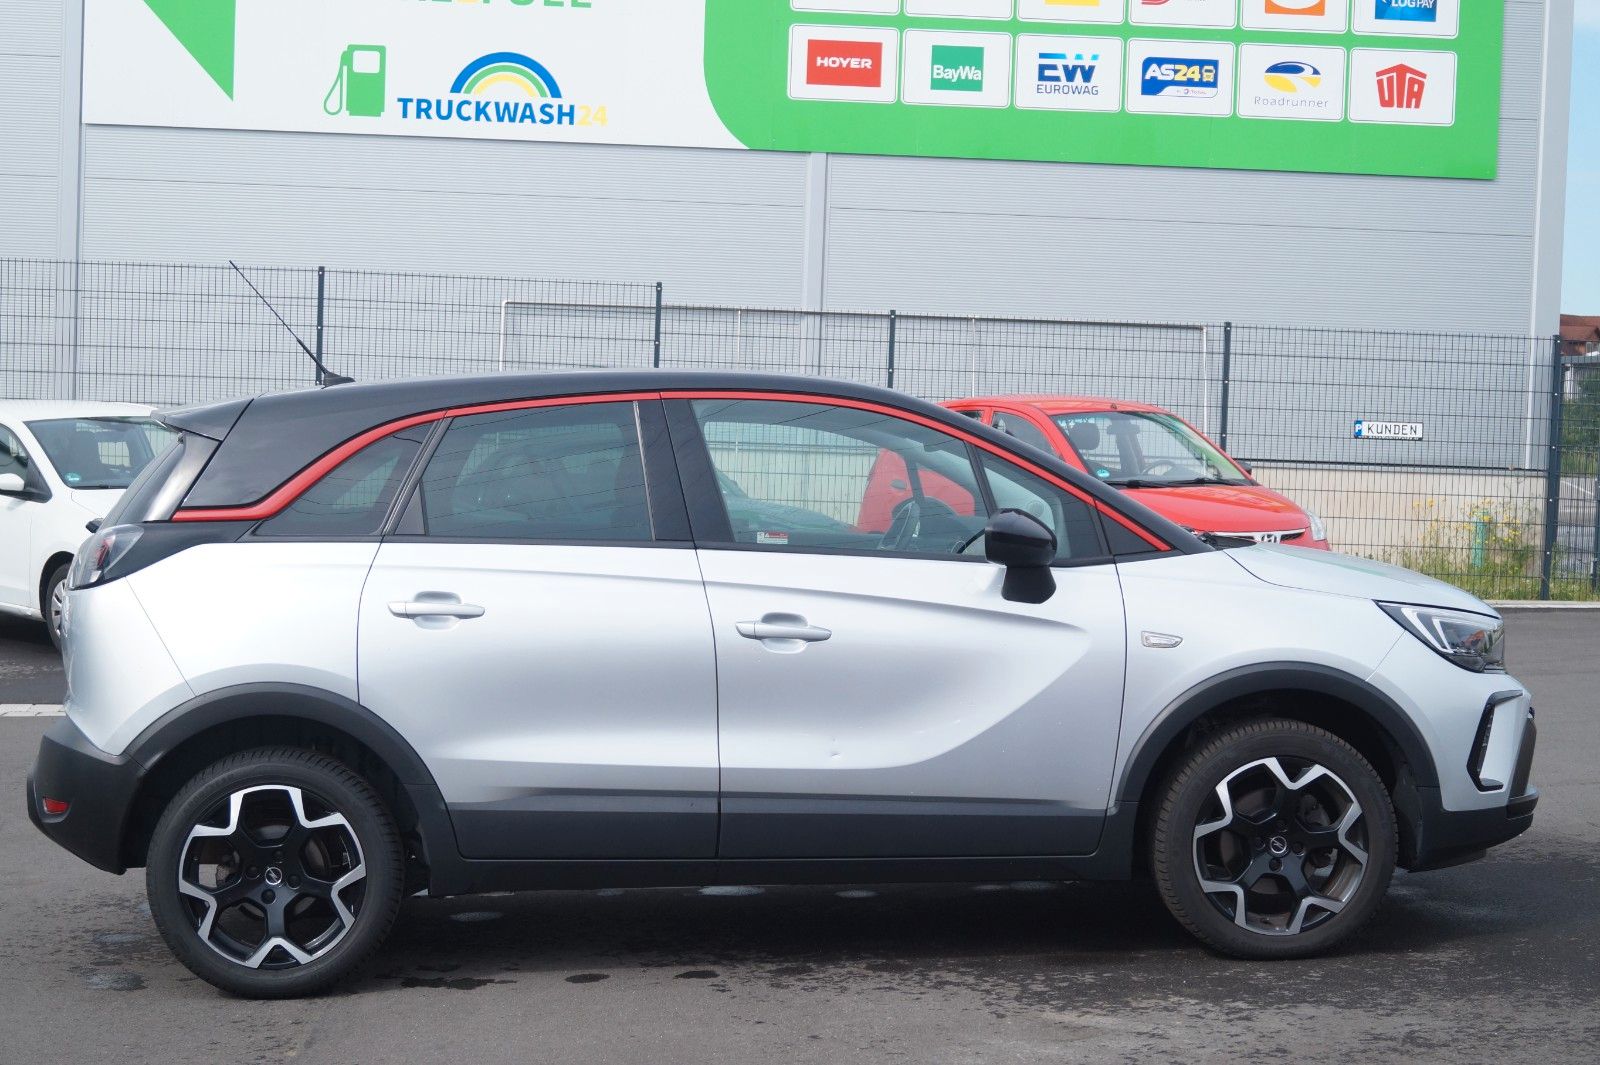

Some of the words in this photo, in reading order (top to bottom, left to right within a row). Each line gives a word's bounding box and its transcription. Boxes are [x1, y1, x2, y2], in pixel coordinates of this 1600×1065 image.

[816, 56, 872, 69] HOYER
[933, 64, 982, 83] BayWa
[1144, 63, 1200, 82] AS24
[1036, 84, 1099, 95] EUROWAG
[1376, 63, 1427, 109] UTA
[1254, 96, 1329, 108] Roadrunner
[1367, 423, 1418, 436] KUNDEN
